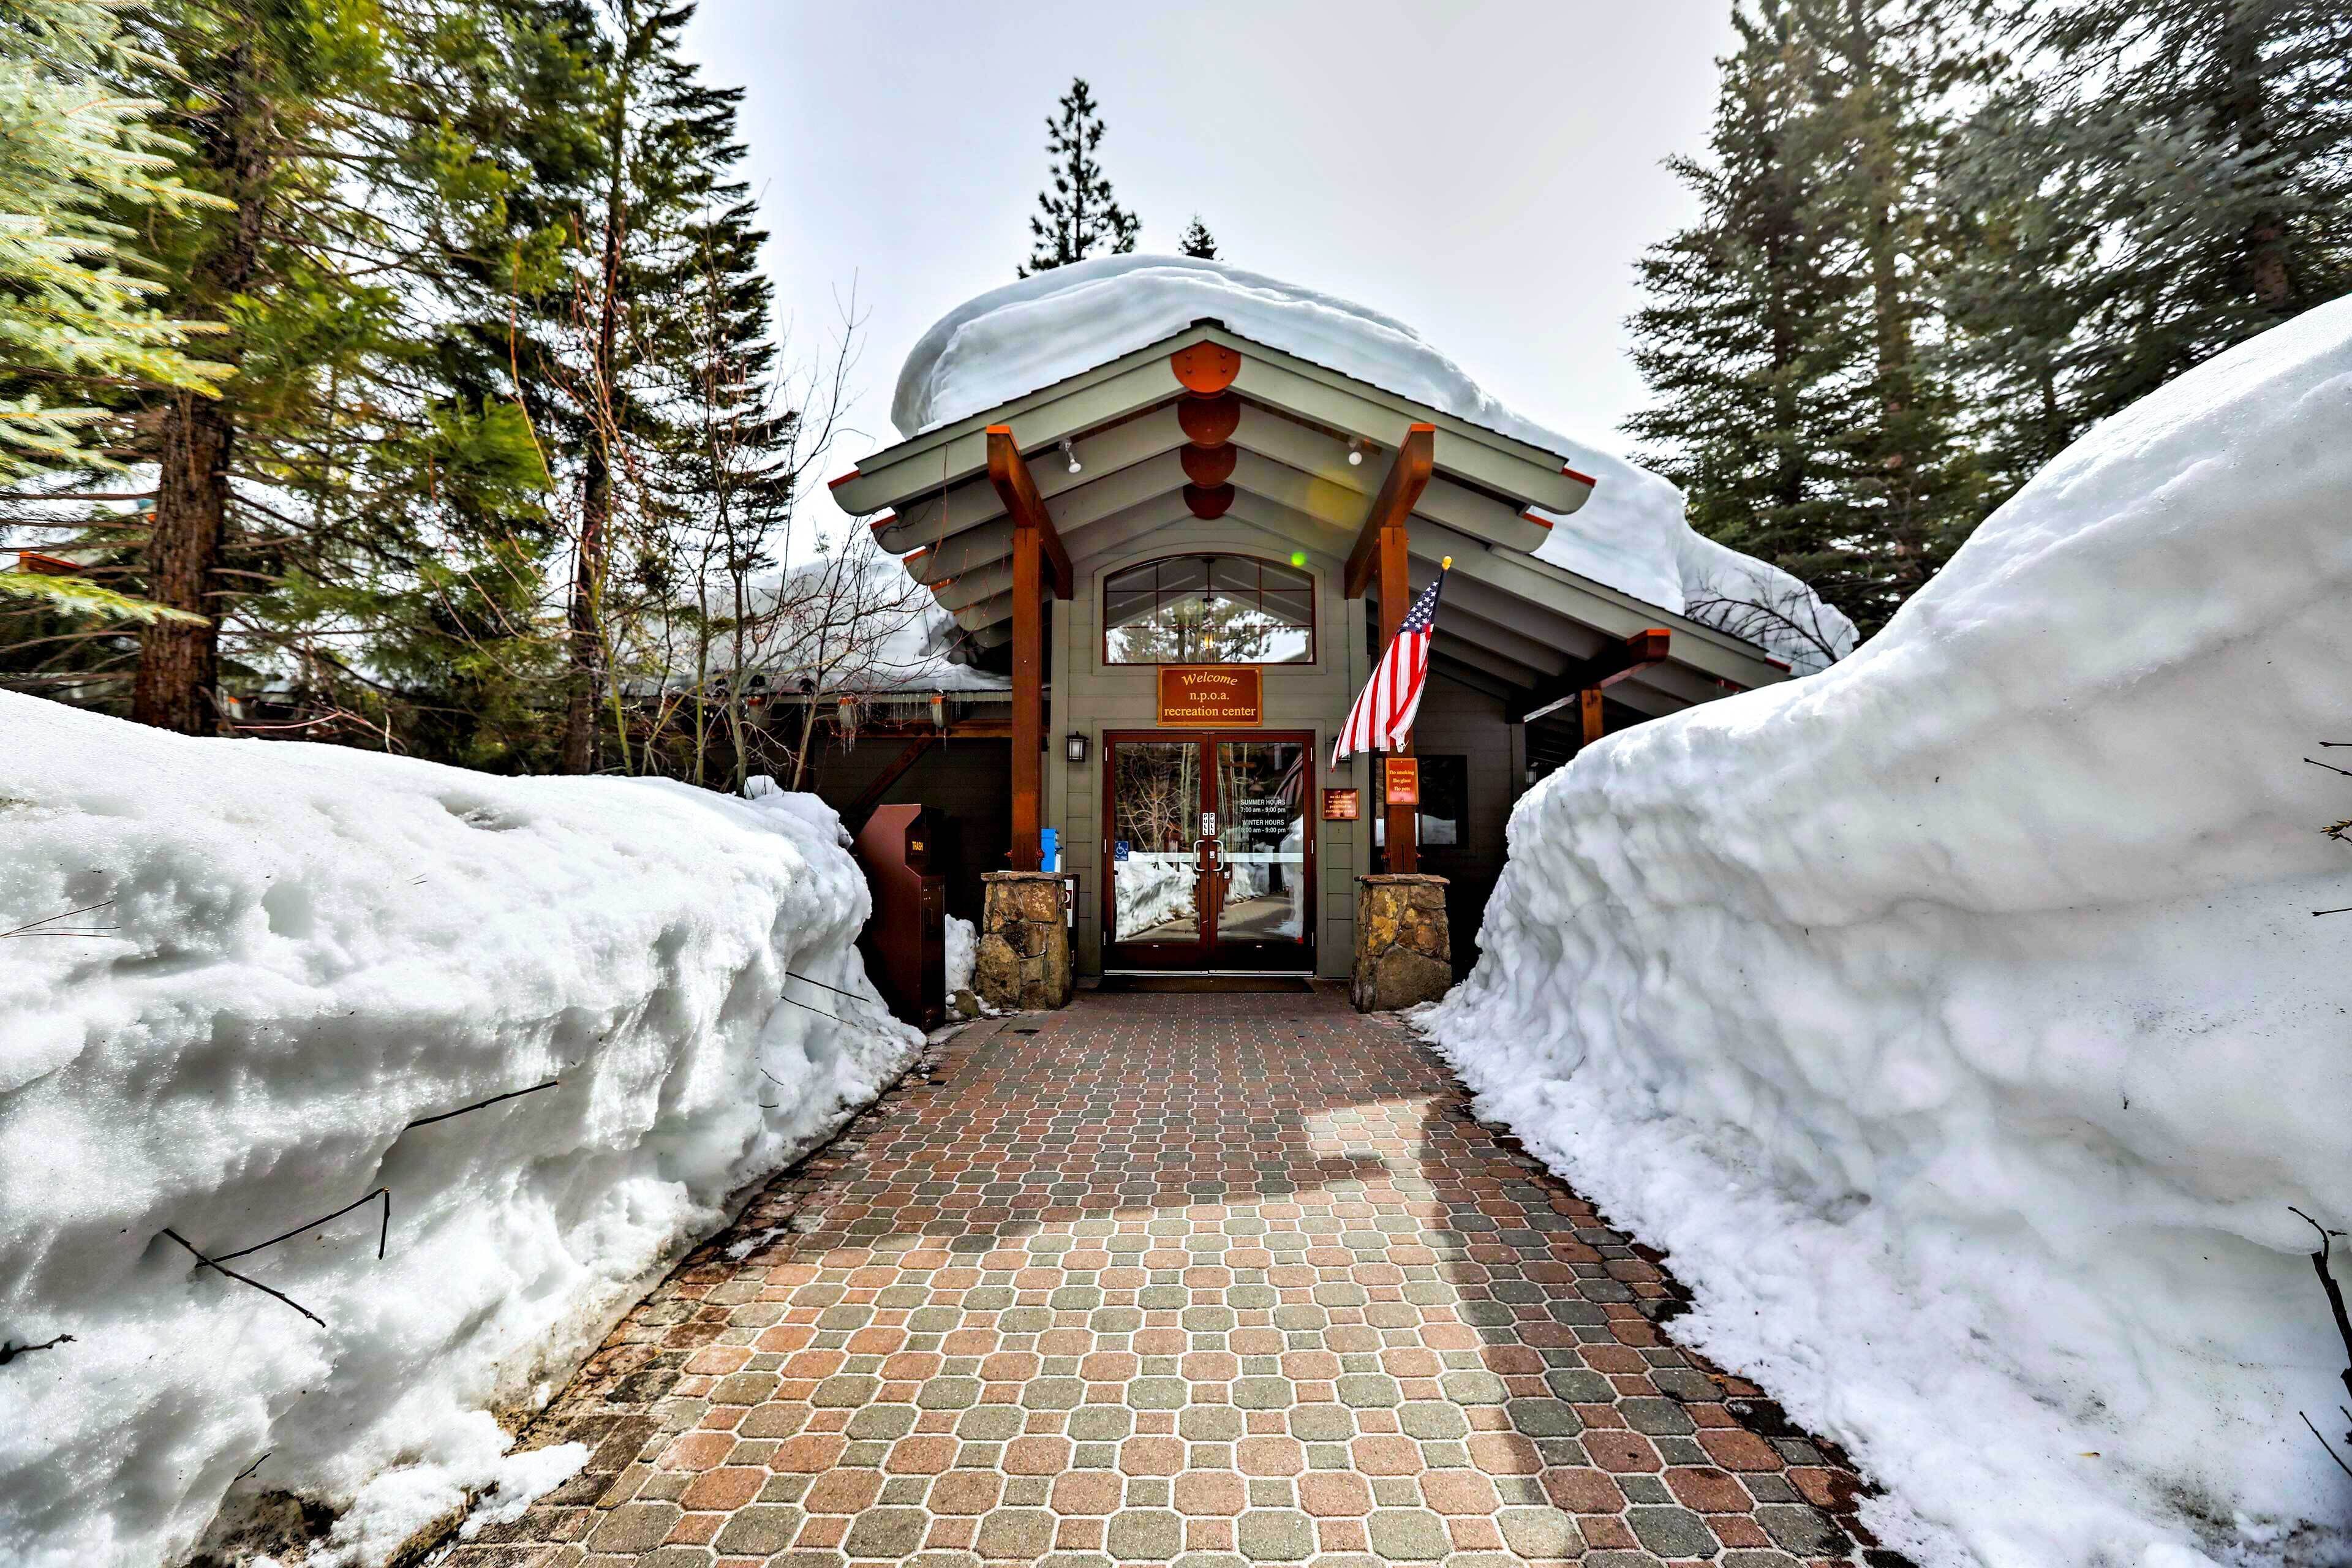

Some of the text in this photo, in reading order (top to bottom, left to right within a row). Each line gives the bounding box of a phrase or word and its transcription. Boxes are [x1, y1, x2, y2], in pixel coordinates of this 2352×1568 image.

[1181, 672, 1238, 685] Welcome
[1189, 692, 1229, 703] n.p.o.a.
[1164, 706, 1256, 716] recreation center
[912, 841, 924, 851] TRASH
